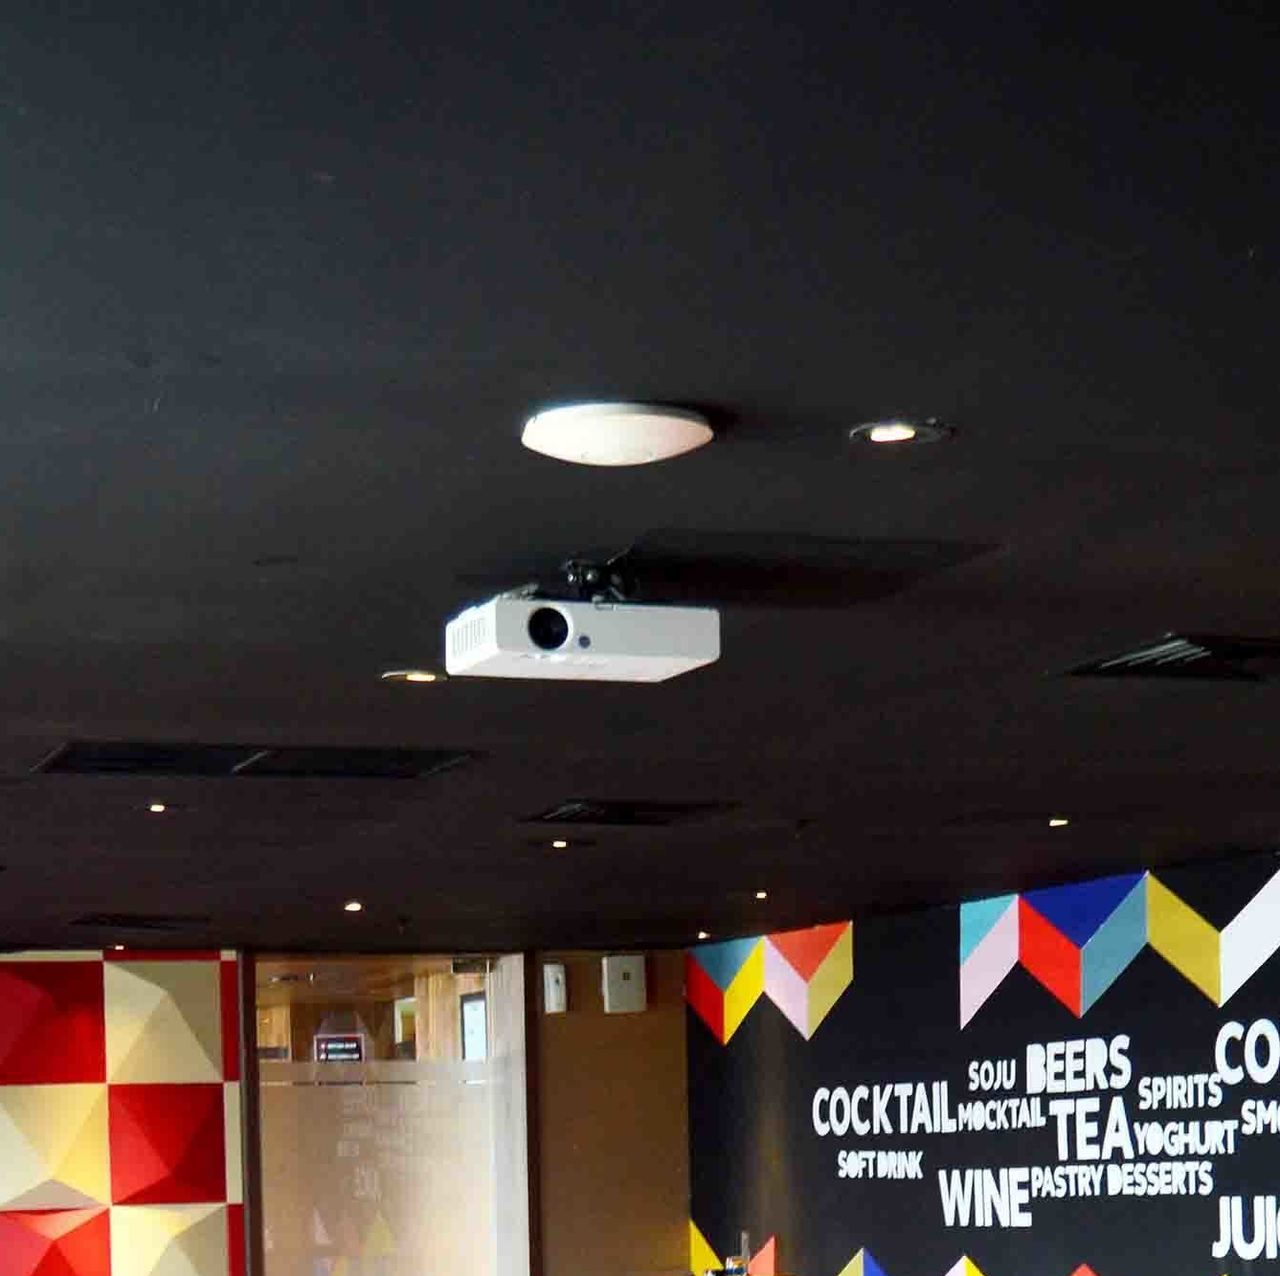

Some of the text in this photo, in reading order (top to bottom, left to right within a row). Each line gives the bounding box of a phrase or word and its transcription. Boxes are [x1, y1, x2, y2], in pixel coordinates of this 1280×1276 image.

[967, 1059, 1016, 1091] SOJU
[1026, 1034, 1132, 1094] BEERS
[812, 1081, 958, 1137] COCKTAIL
[1138, 1072, 1223, 1110] SPIRITS
[957, 1097, 1046, 1131] MOCKTAIL
[1049, 1096, 1135, 1161] TEA
[1133, 1119, 1239, 1157] YOGHURT
[837, 1149, 924, 1180] SOFT DRINK
[1030, 1160, 1214, 1198] PASTRY DESSERTS
[938, 1167, 1033, 1228] WINE
